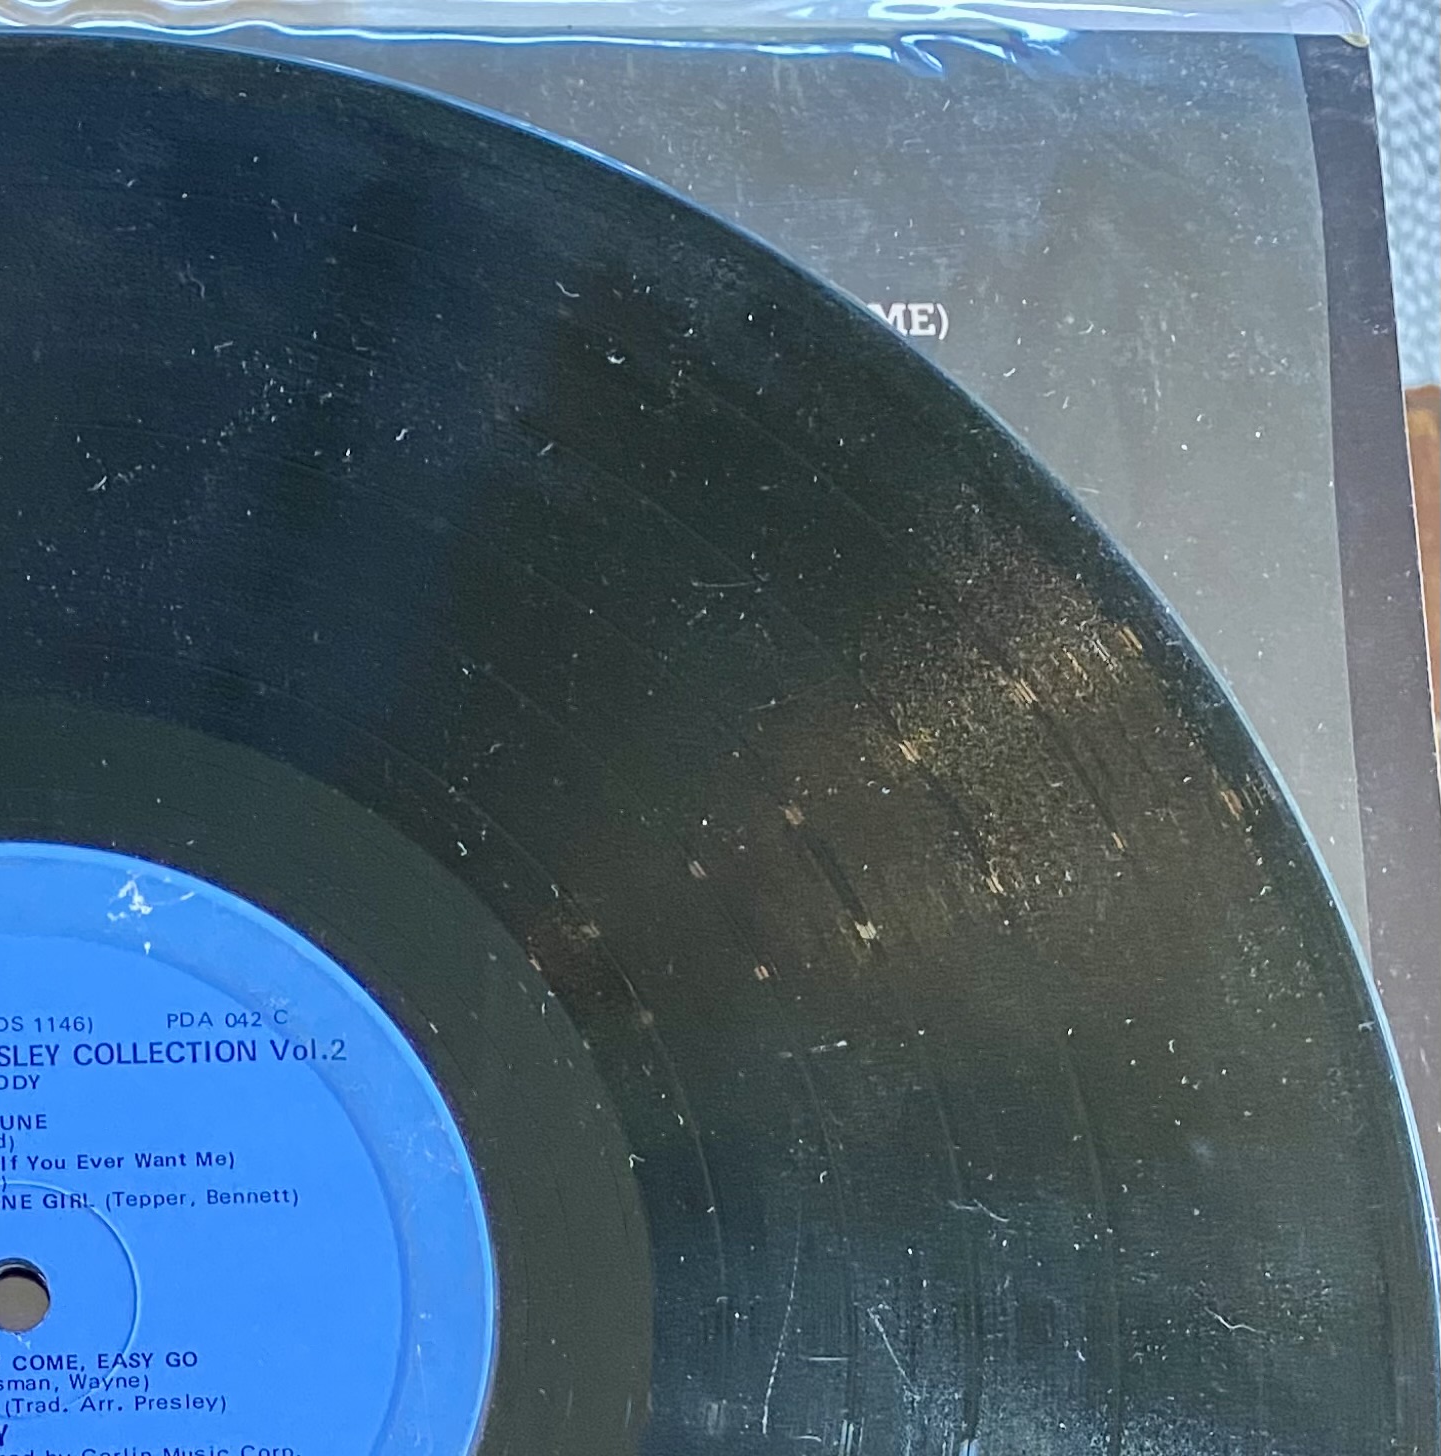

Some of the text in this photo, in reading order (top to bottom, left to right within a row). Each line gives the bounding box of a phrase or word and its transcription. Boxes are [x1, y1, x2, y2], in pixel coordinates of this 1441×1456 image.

[34, 1016, 93, 1034] 1146)
[166, 1011, 263, 1029] PDA 042
[73, 1039, 257, 1066] COLLECTION
[270, 1037, 348, 1062] Vol.2
[27, 1154, 66, 1171] You
[77, 1153, 124, 1170] Ever
[134, 1152, 187, 1169] Want
[196, 1151, 235, 1170] Me)
[42, 1192, 95, 1210] GIRL
[105, 1191, 196, 1213] (Tepper,
[207, 1188, 299, 1208] Bennett)
[12, 1354, 86, 1372] COME,
[97, 1352, 154, 1369] EASY
[165, 1351, 198, 1367] GO
[69, 1374, 149, 1392] Wayne)
[5, 1397, 69, 1417] (Trad.
[79, 1396, 123, 1412] Arr.
[134, 1394, 227, 1414] Presley)
